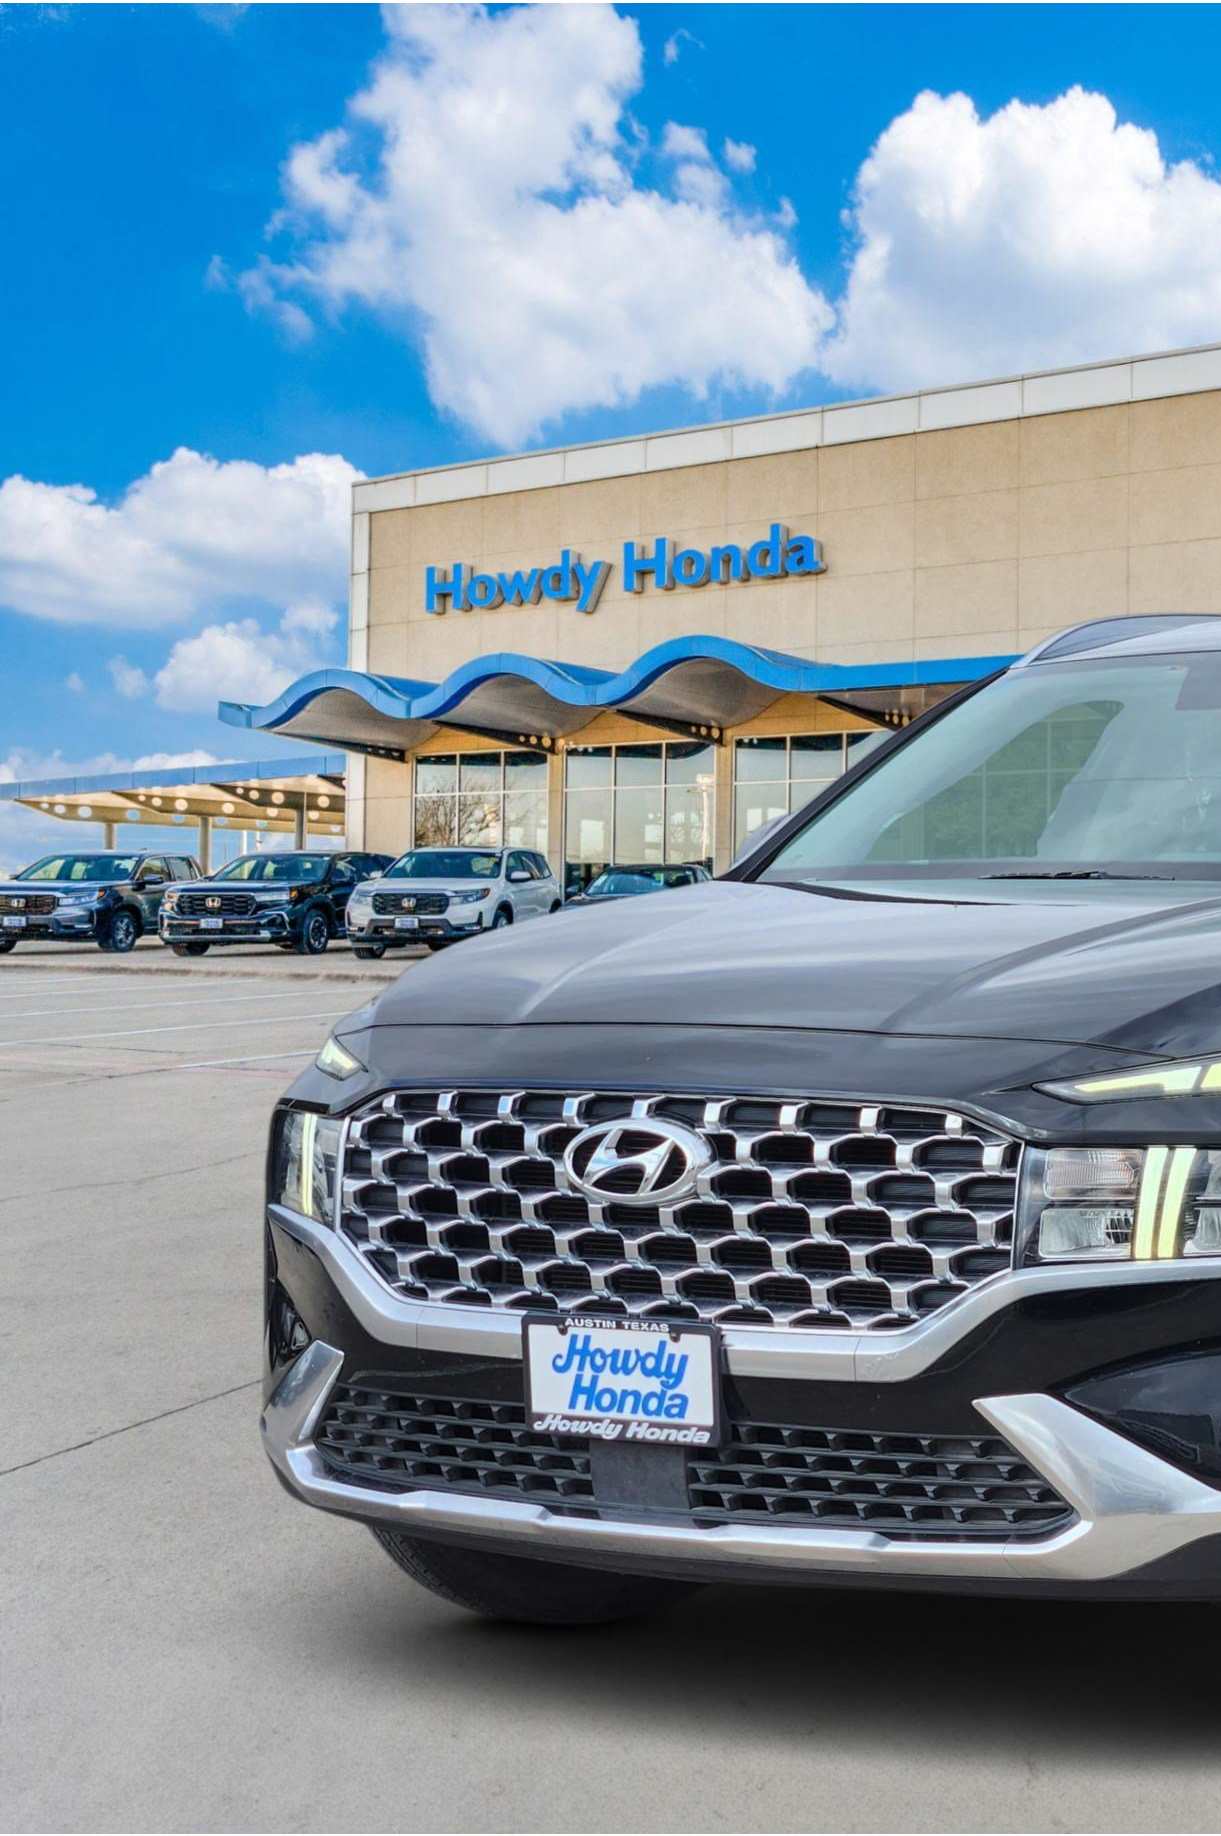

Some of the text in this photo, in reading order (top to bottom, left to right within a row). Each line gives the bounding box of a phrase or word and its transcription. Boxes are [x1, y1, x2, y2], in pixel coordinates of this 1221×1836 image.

[425, 522, 825, 614] Howdy Honda
[564, 1317, 671, 1333] AUSTIN TEXAS
[552, 1333, 689, 1390] Howdy
[567, 1373, 689, 1419] Honda
[532, 1414, 711, 1444] Howdy Honda
